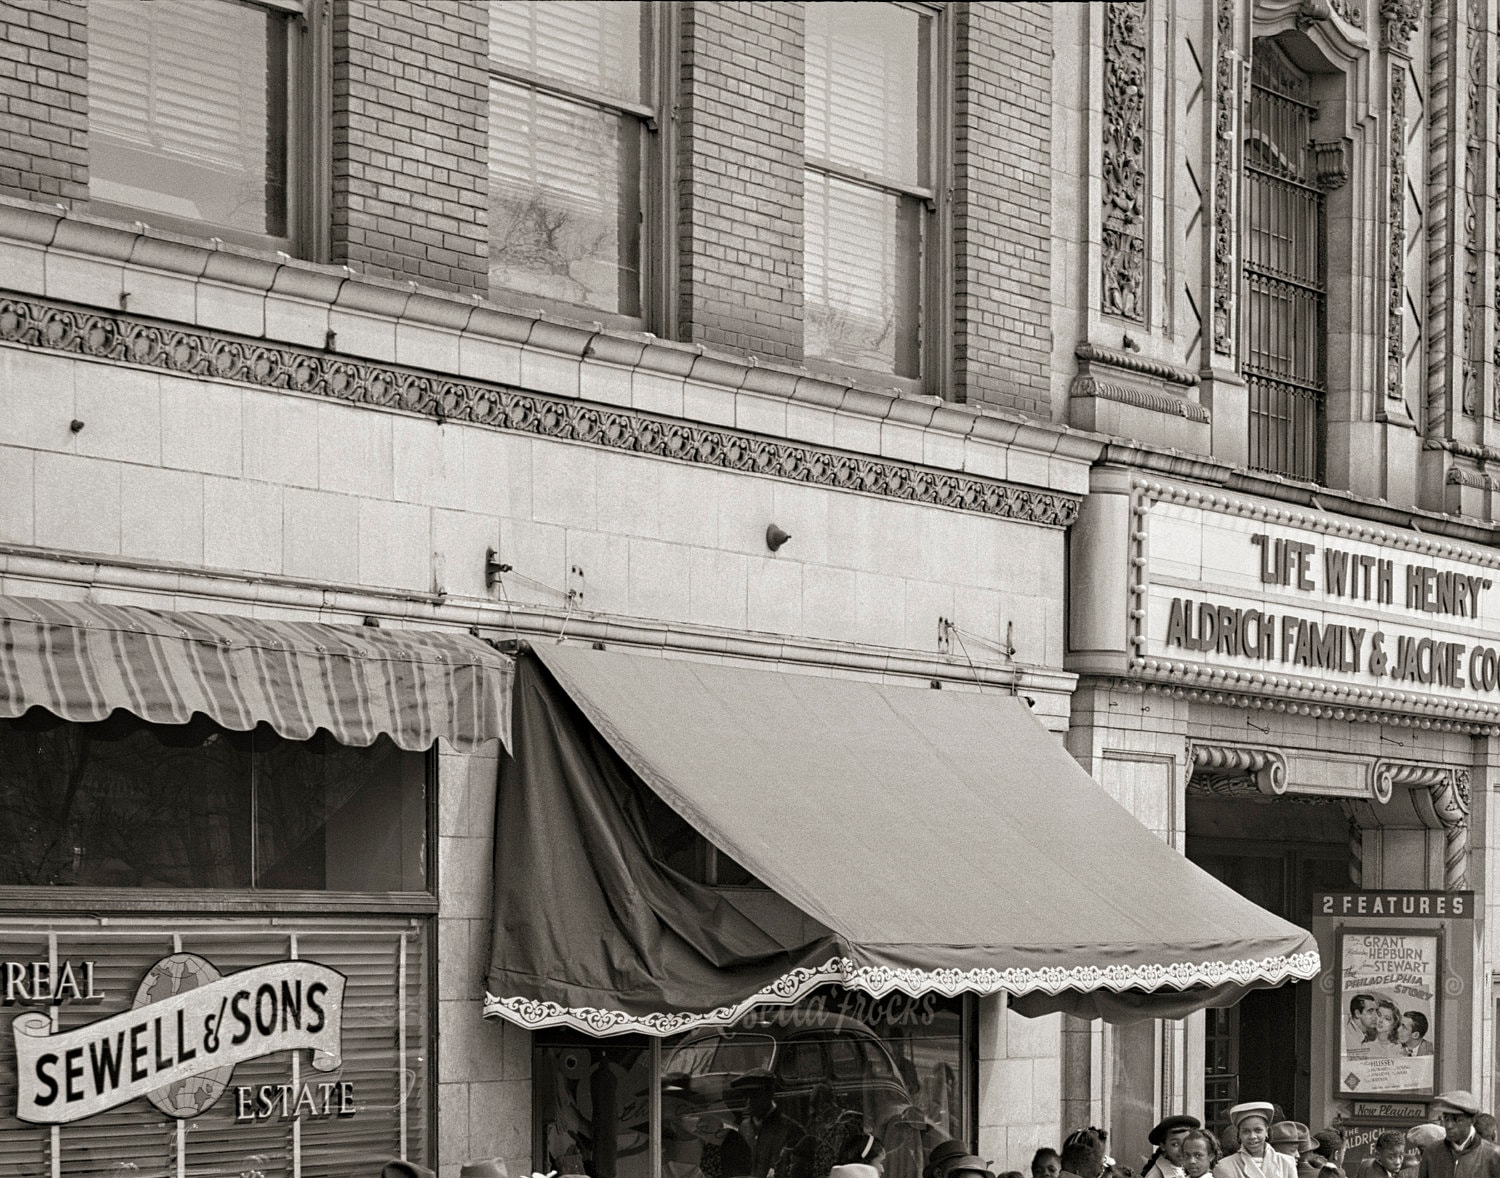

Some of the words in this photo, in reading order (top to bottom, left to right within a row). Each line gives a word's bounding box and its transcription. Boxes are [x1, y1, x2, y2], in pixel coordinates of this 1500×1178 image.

[1325, 548, 1394, 605] WITH
[1168, 598, 1275, 660] ALDRICH
[1282, 615, 1367, 673] FAMILY
[1371, 631, 1390, 676] &
[1391, 635, 1467, 689] JACKIE
[1323, 896, 1334, 914] 2
[1343, 896, 1465, 915] FEATURES
[1363, 935, 1406, 948] GRANT
[1369, 948, 1423, 960] HEPBURN
[1374, 960, 1429, 972] STEWART
[5, 961, 104, 1001] REAL
[1344, 973, 1423, 990] PHILADELPHIA
[1393, 984, 1433, 1000] STORY
[35, 1009, 197, 1107] SEWELL
[231, 978, 328, 1045] SONS
[238, 1081, 355, 1120] ESTATE
[1357, 1104, 1377, 1116] Now
[1344, 1128, 1359, 1138] THE
